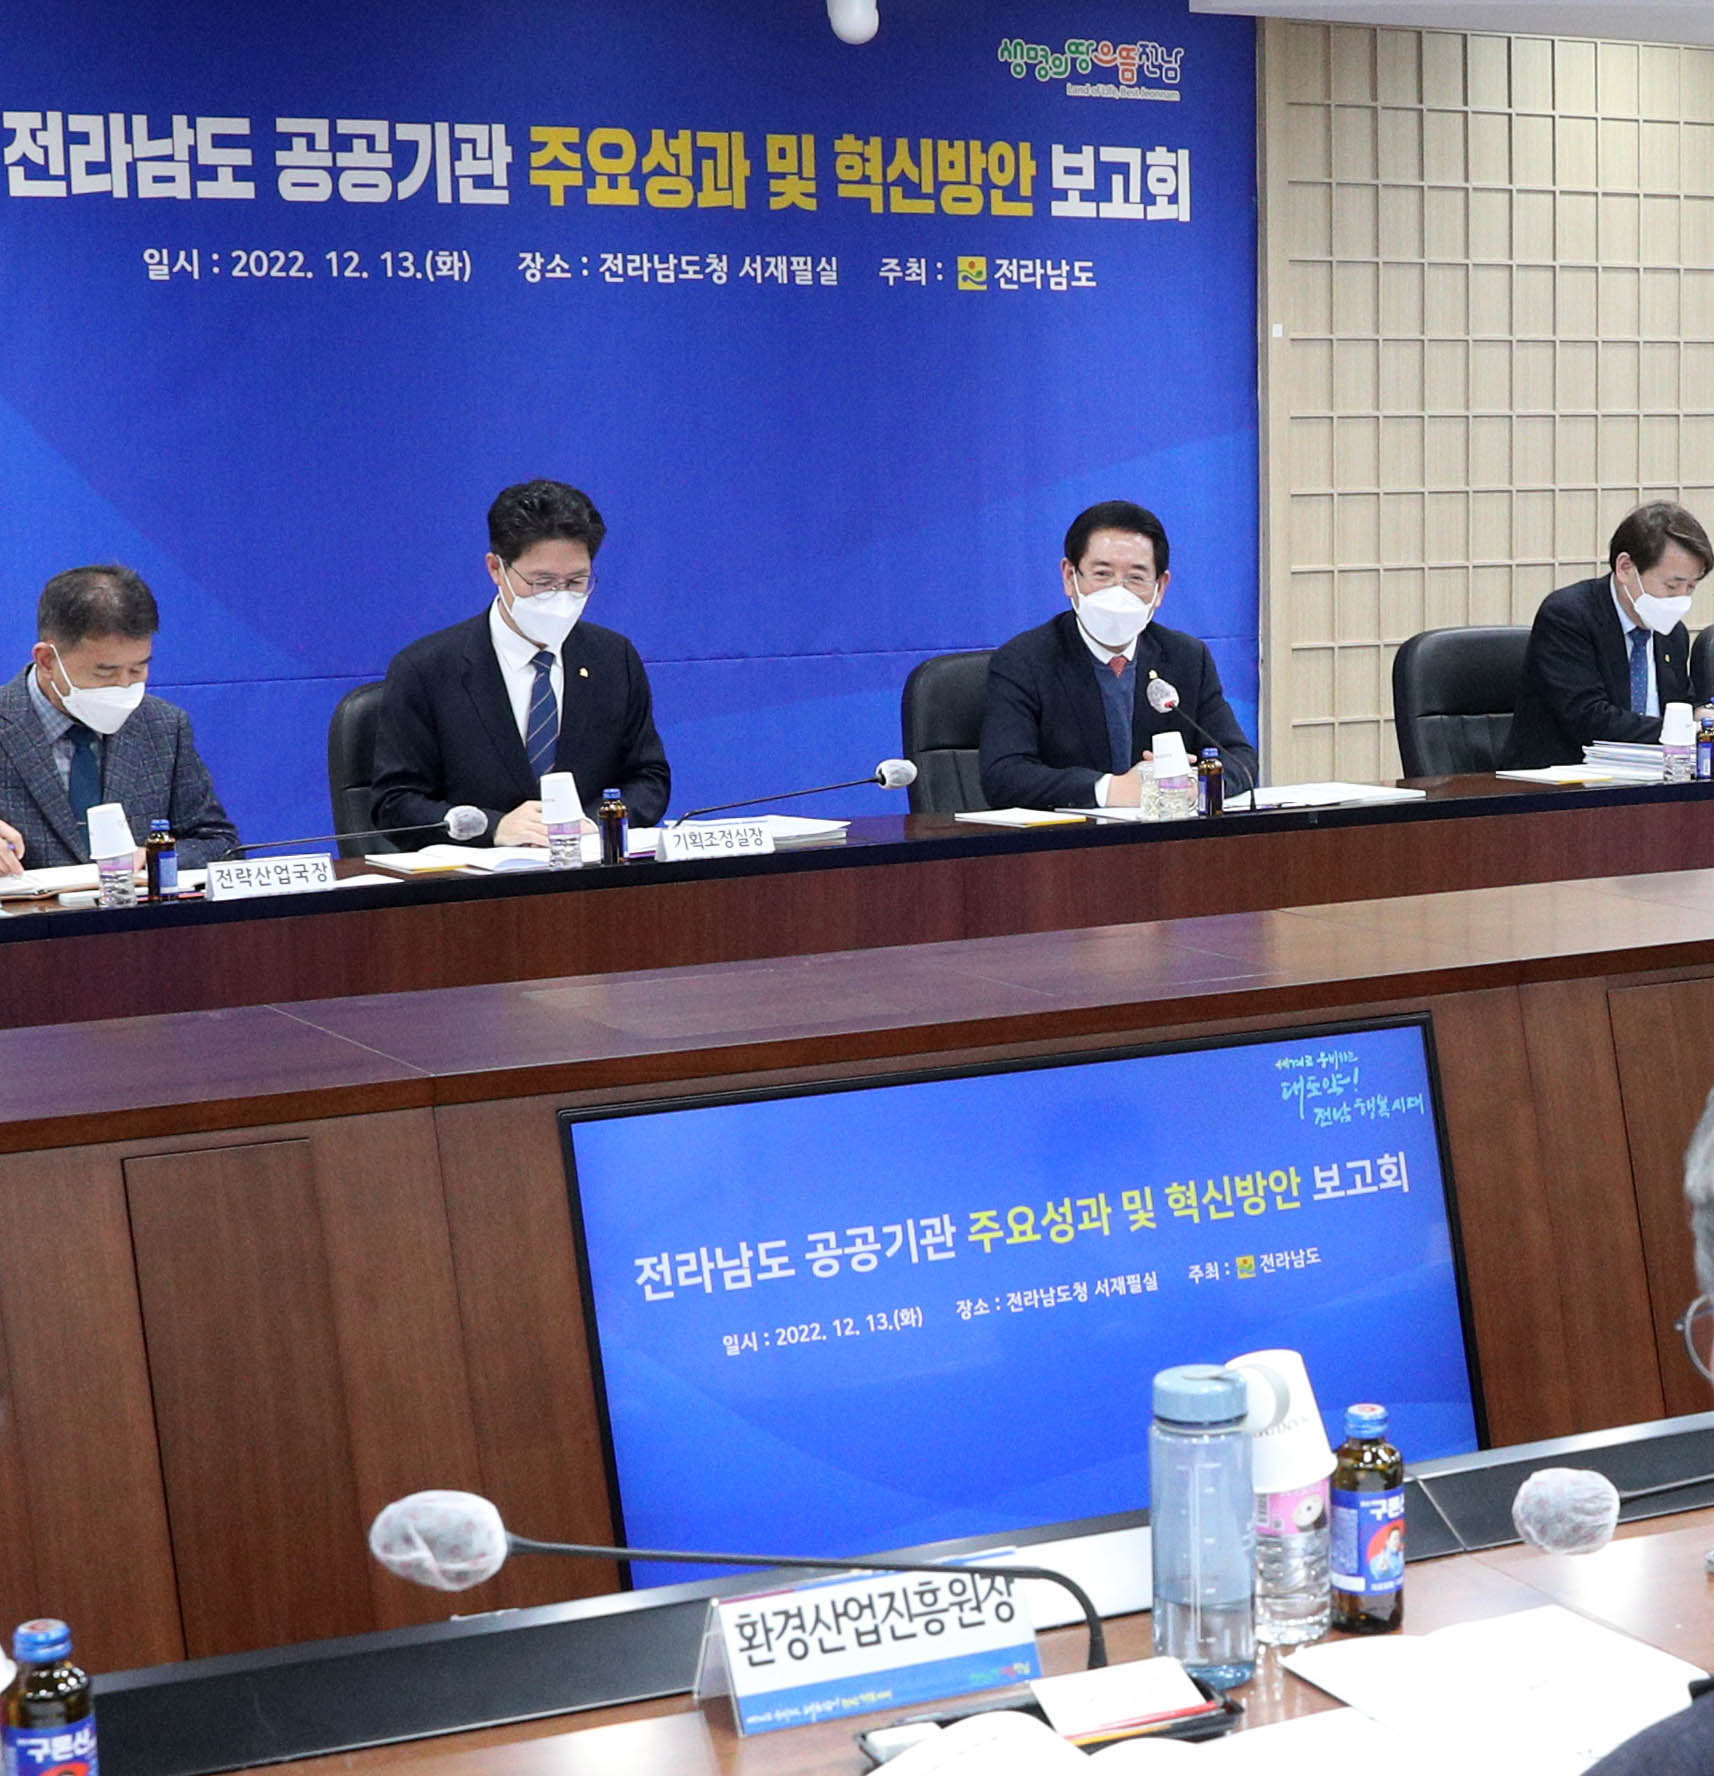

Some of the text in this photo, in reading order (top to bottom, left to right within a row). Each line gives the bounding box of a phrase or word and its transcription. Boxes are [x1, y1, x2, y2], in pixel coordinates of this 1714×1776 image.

[2, 110, 1191, 222] 전라남도 공공기관 주요성과 및 혁신방안 보고회
[143, 248, 200, 280] 일시
[230, 250, 313, 278] 2022.
[326, 251, 369, 278] 12.
[381, 249, 472, 282] 13.(화)
[518, 251, 571, 283] 장소
[598, 252, 730, 286] 전라남도청
[738, 254, 839, 286] 서재필실
[878, 256, 927, 287] 주최
[993, 258, 1097, 290] 전라남도
[673, 826, 764, 851] 기획조정실장
[215, 861, 329, 890] 전략산업국장
[1280, 1066, 1360, 1121] 대도약!
[1313, 1101, 1352, 1129] 전남
[633, 1150, 1410, 1302] 전라남도 공공기관 주요성과 및 혁신방안 보고회
[721, 1330, 759, 1357] 일시
[774, 1321, 828, 1348] 2022.
[831, 1317, 861, 1338] 12.
[865, 1305, 924, 1334] 13.(화)
[955, 1294, 991, 1321] 장소
[1005, 1280, 1090, 1314] 전라남도청
[1094, 1270, 1159, 1299] 서재필실
[1188, 1262, 1221, 1286] 주최
[1259, 1246, 1322, 1275] 전라남도
[734, 1572, 1016, 1667] 환경산업진흥원장
